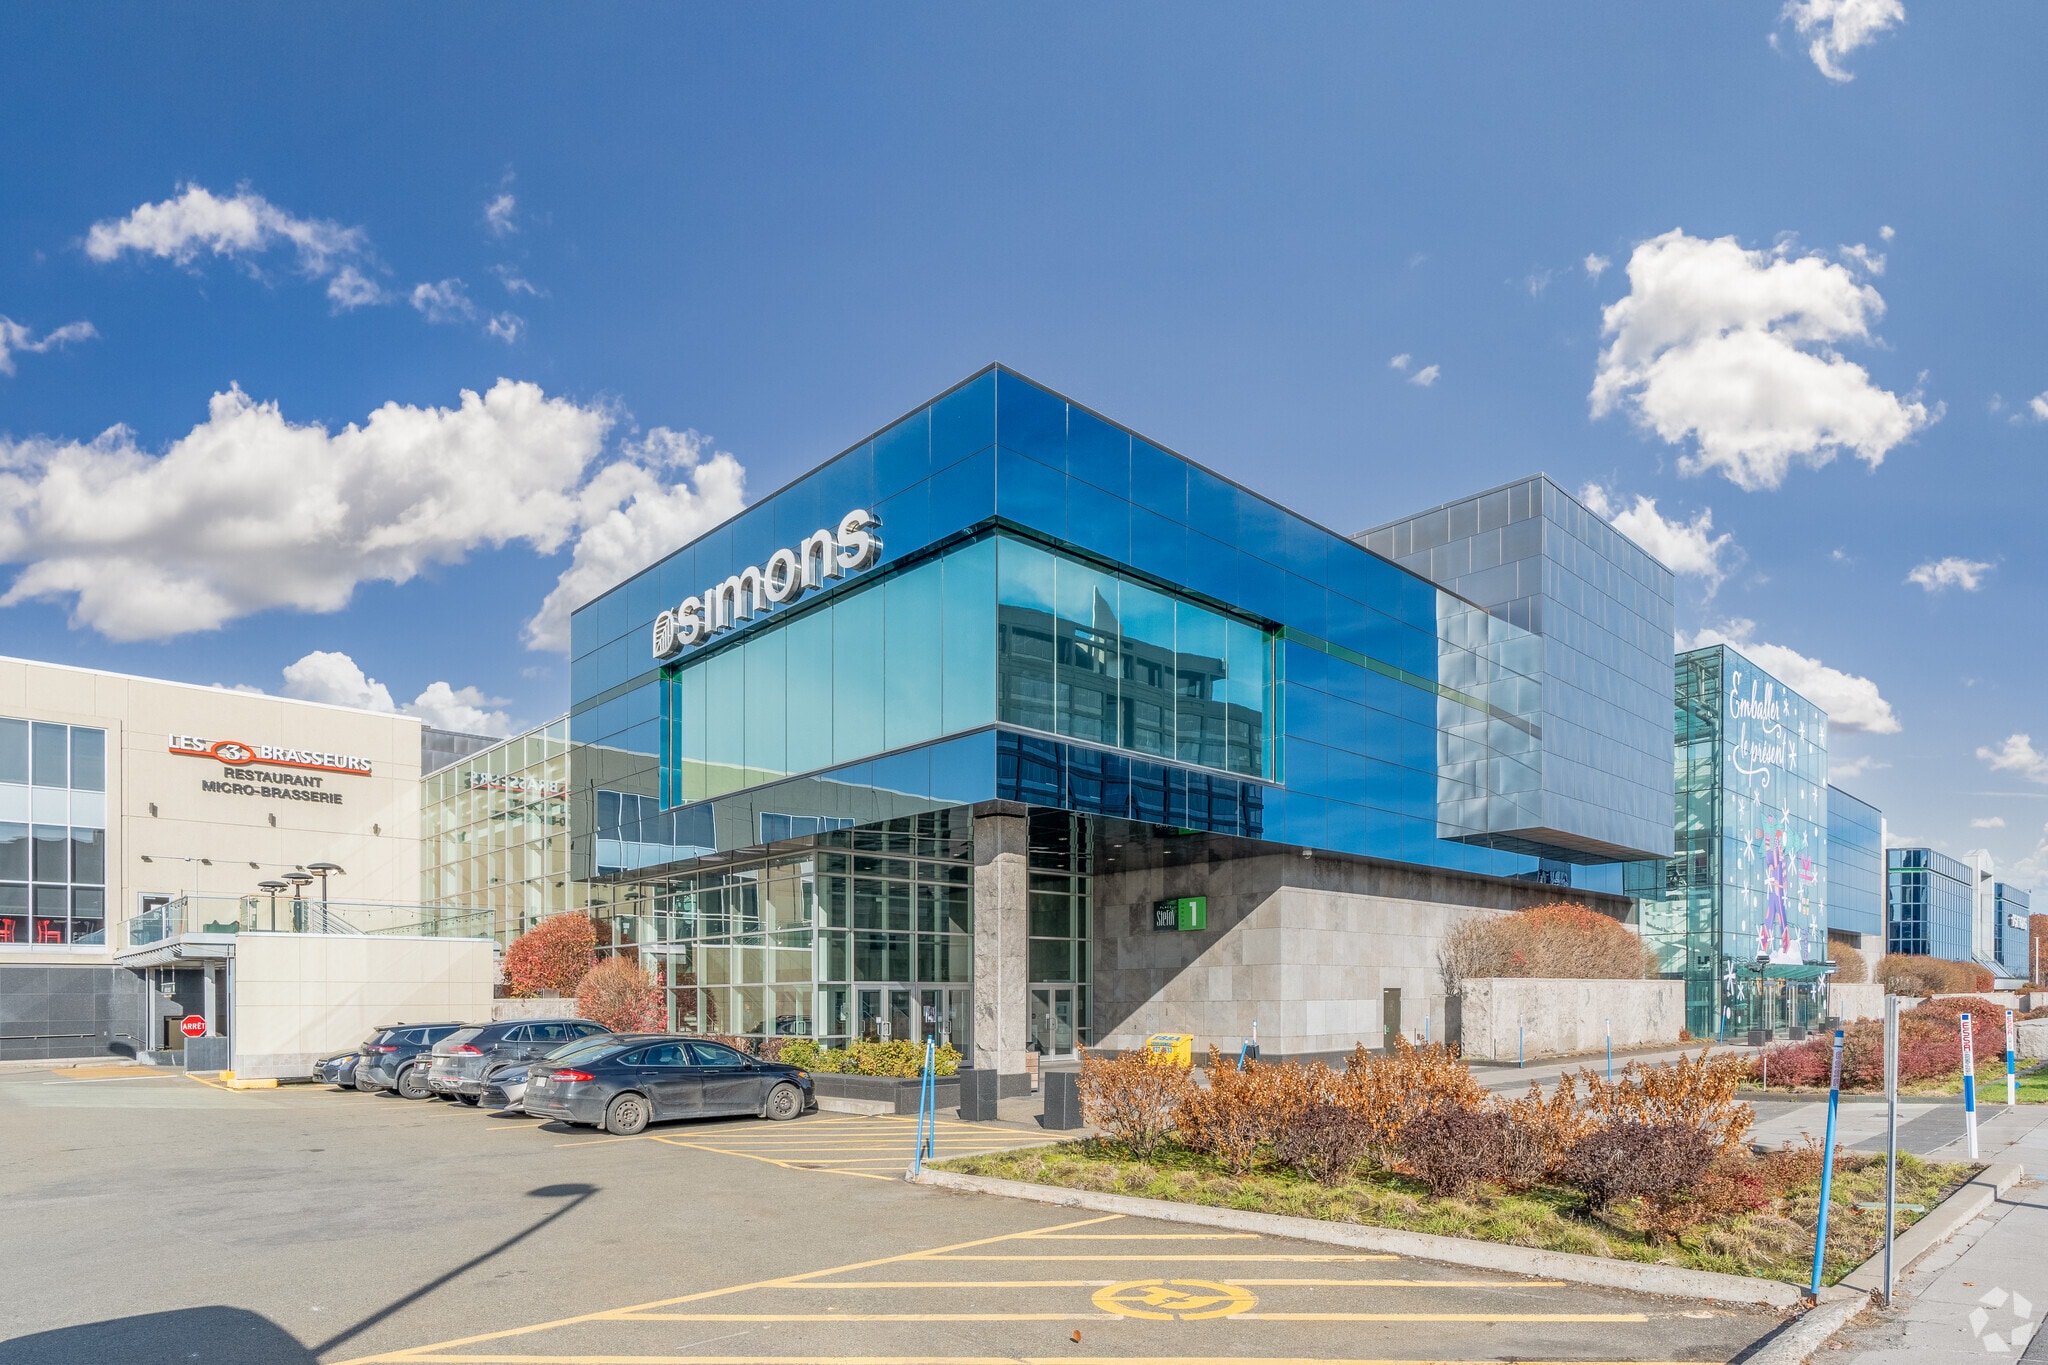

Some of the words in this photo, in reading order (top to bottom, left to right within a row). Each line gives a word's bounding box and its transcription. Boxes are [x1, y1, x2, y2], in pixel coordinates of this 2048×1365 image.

[677, 508, 883, 648] simons
[1730, 670, 1781, 738] Emballer
[168, 733, 205, 751] LES
[224, 743, 241, 760] 3
[260, 744, 372, 771] BRASSEURS
[1749, 732, 1787, 788] présent
[201, 779, 344, 805] MICRO-BRASSERIE
[223, 766, 323, 789] RESTAURANT
[1188, 901, 1197, 926] 1
[182, 1021, 206, 1030] ARRÊT
[1961, 1021, 1971, 1052] ESSA
